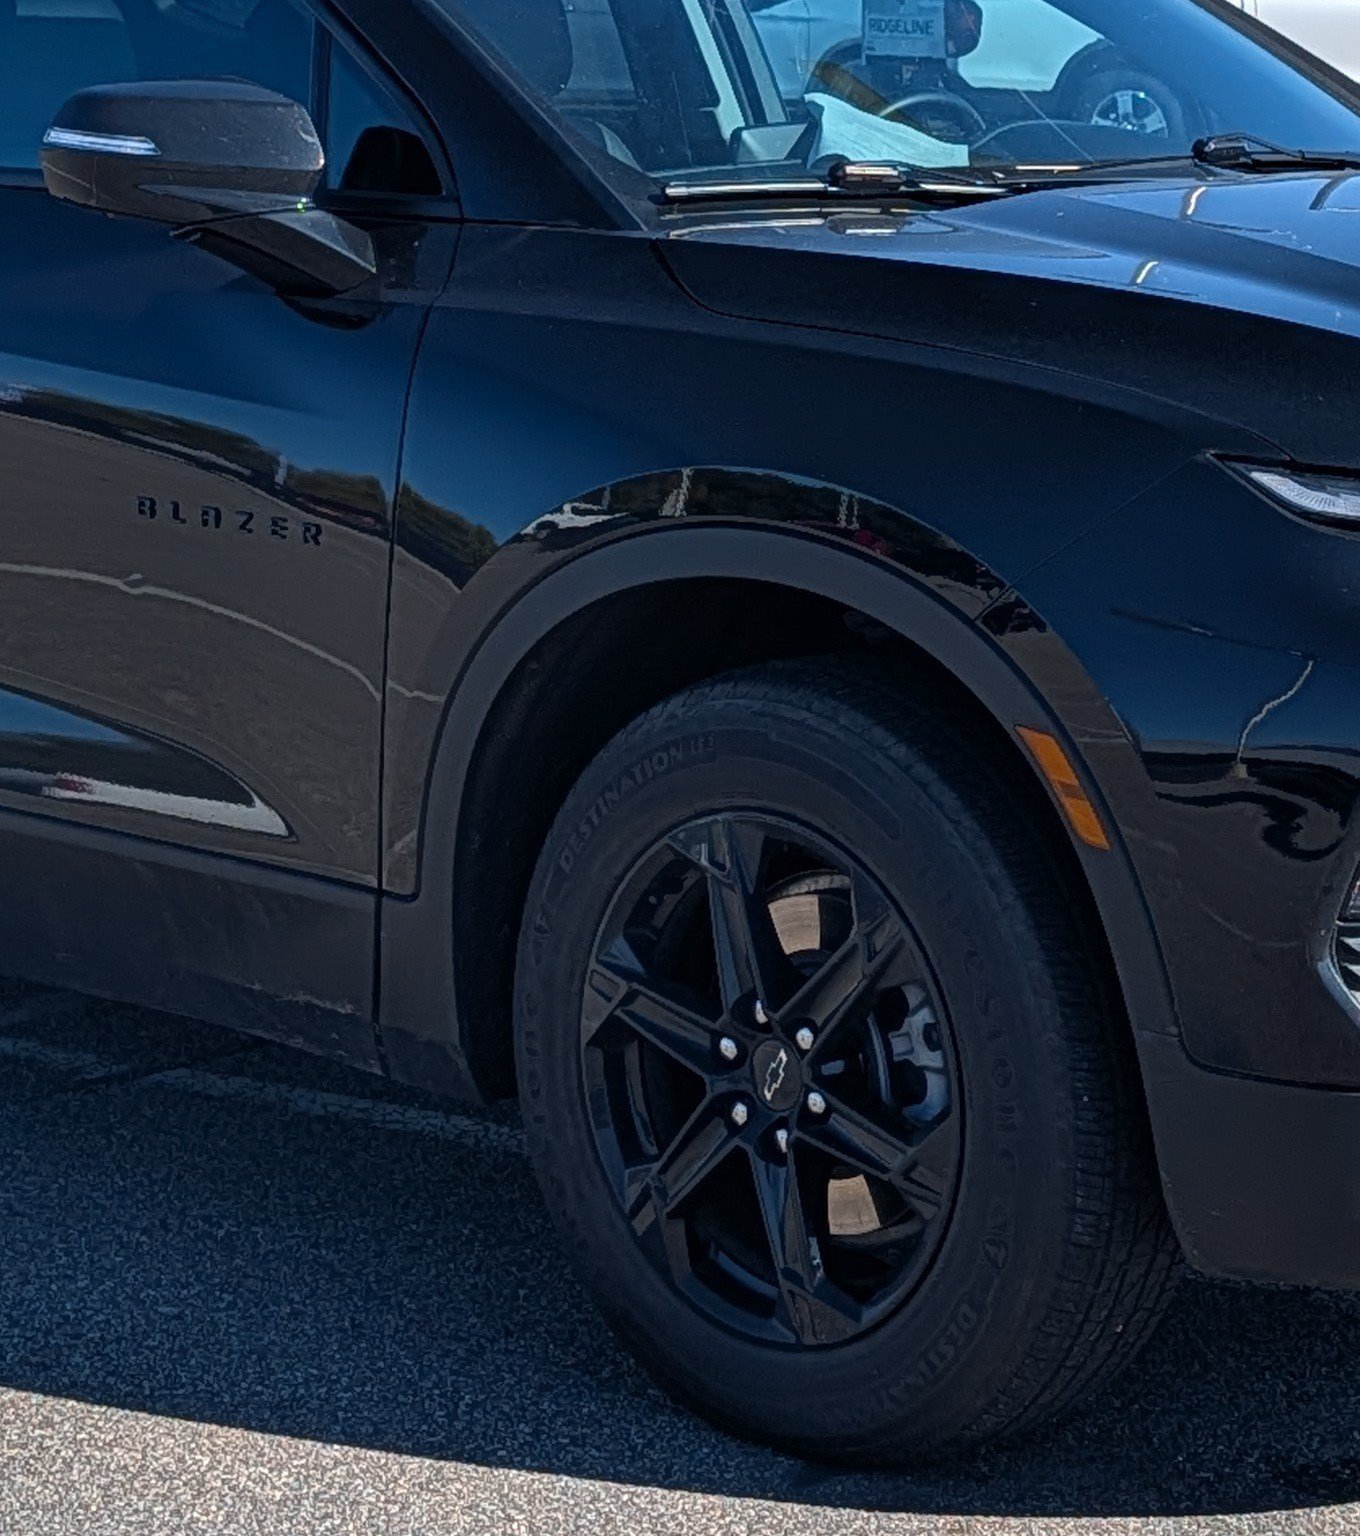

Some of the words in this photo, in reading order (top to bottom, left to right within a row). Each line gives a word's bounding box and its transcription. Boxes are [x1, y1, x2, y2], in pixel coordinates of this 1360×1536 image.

[868, 17, 934, 35] RIDGELINE
[137, 496, 323, 546] BLAZER
[559, 743, 683, 874] DESTINATION
